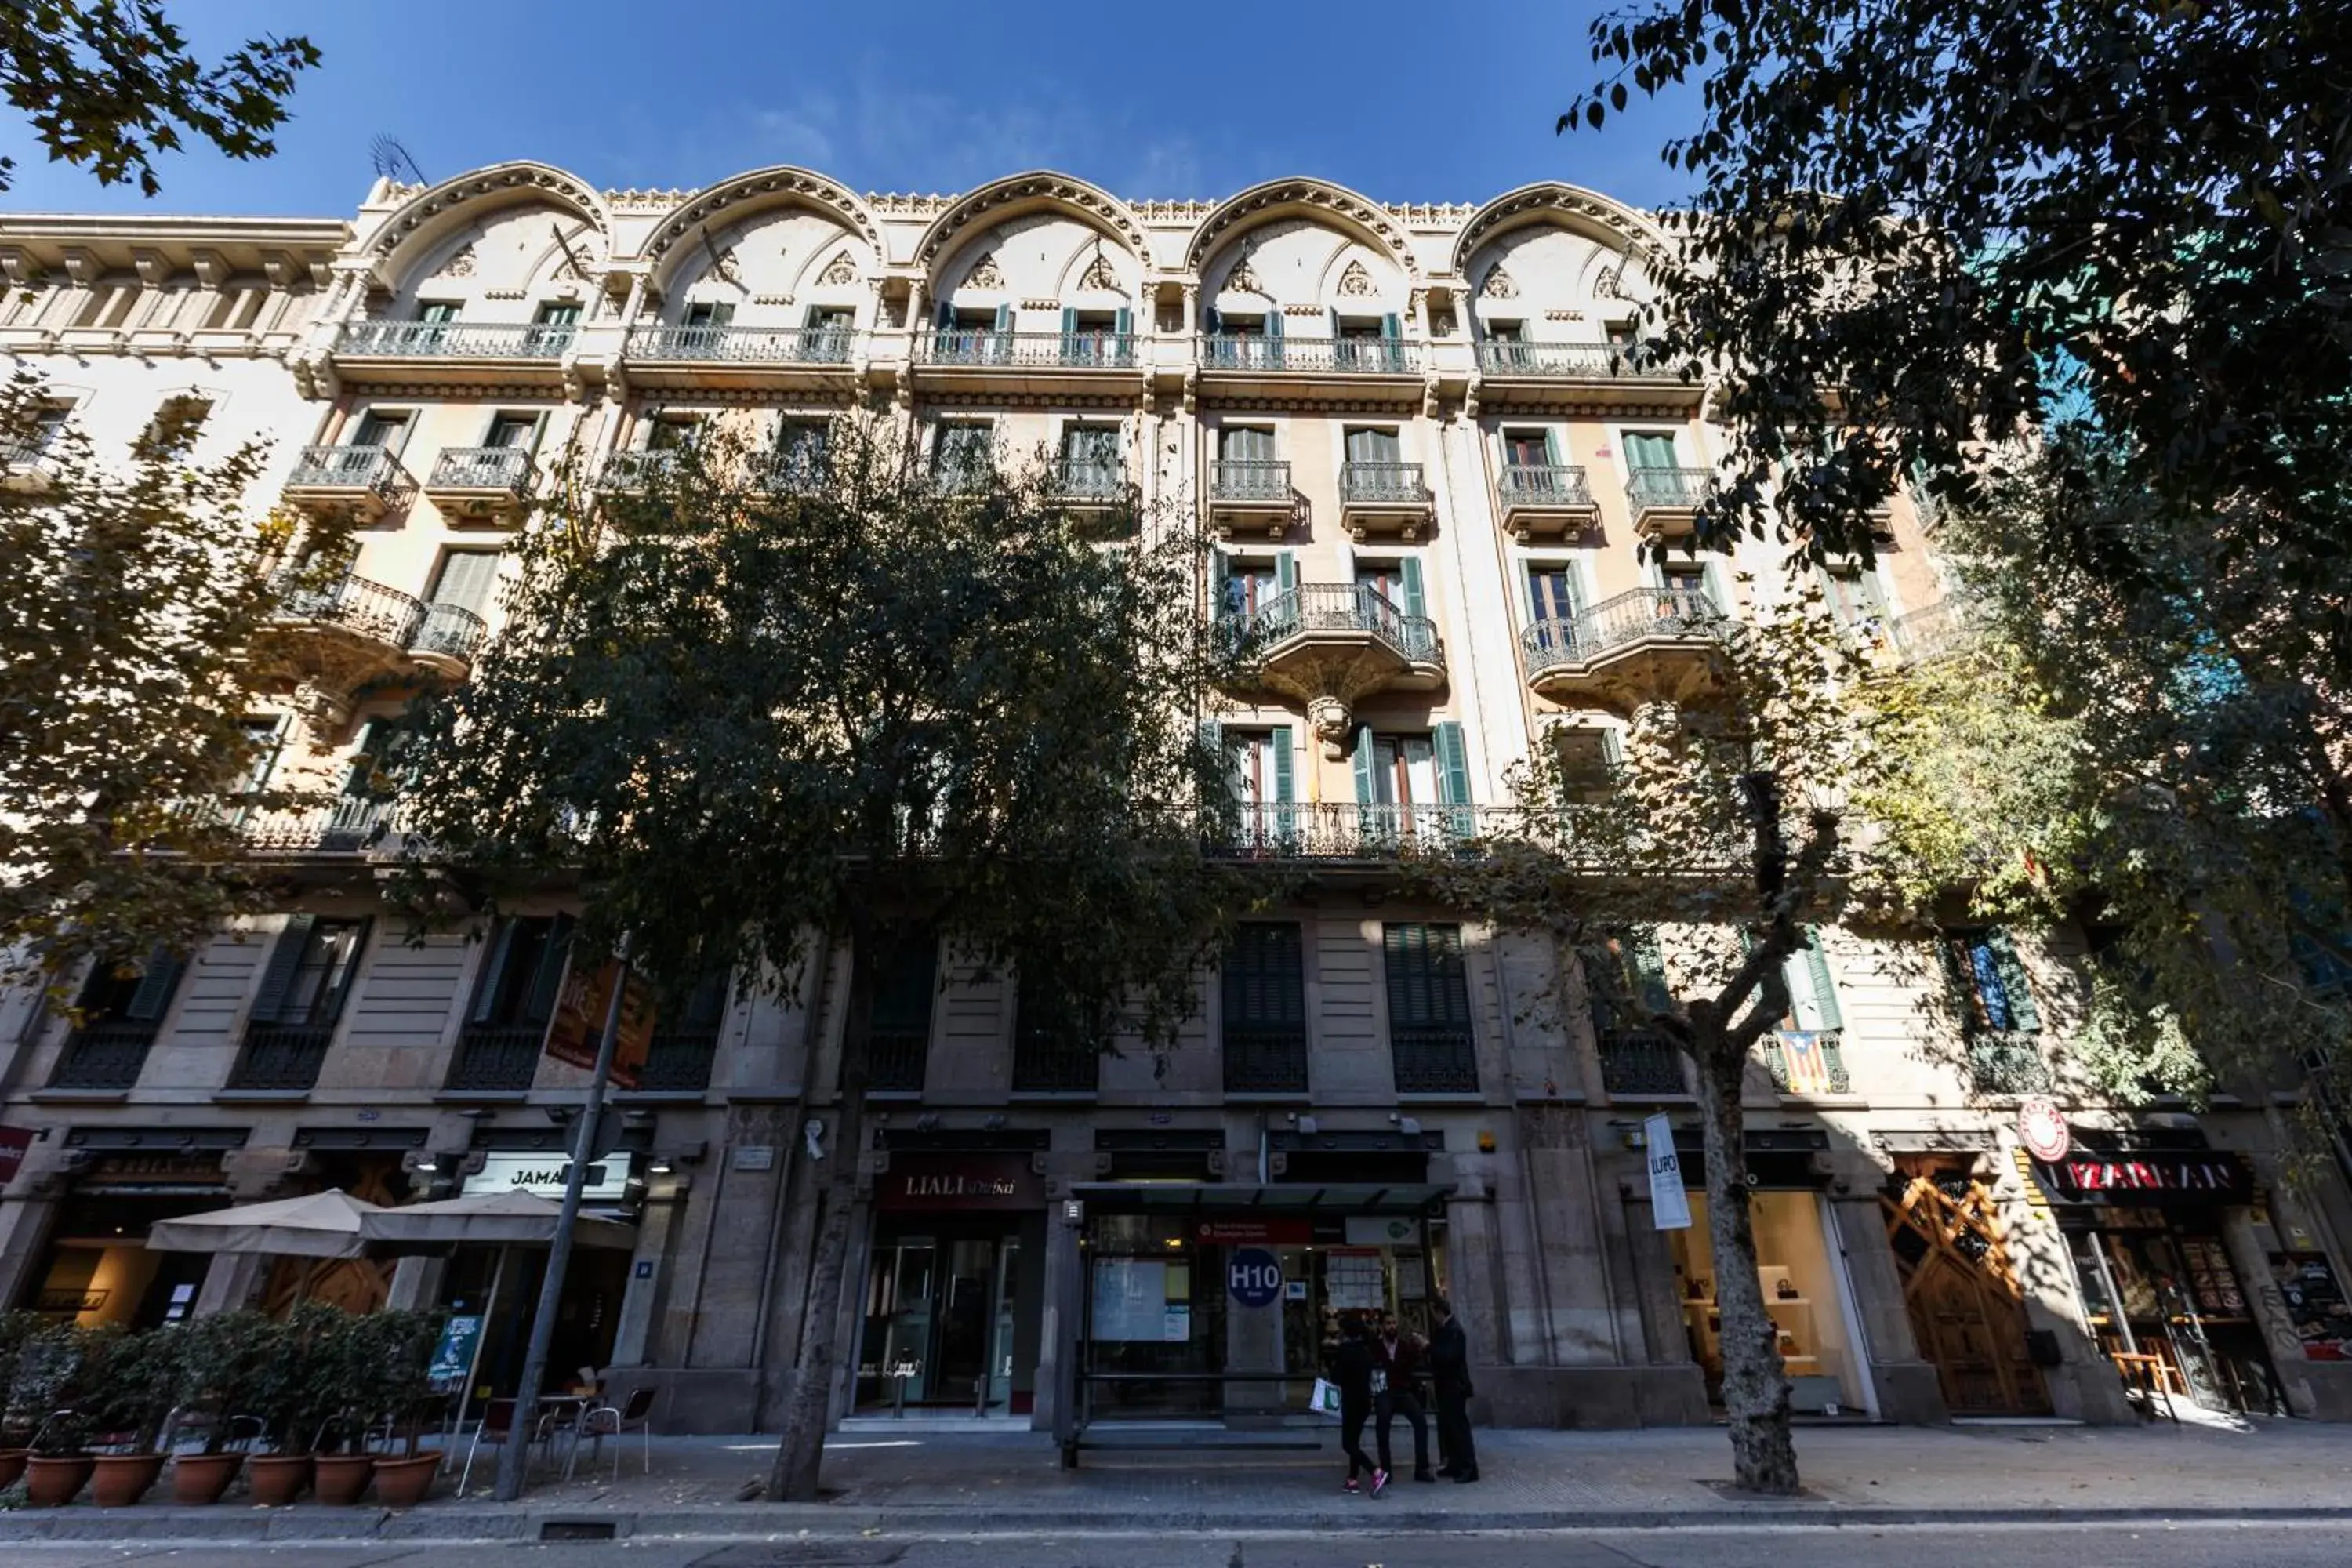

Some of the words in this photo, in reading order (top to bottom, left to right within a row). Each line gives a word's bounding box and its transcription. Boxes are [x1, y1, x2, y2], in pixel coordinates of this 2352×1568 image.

[1651, 1154, 1676, 1174] LUPO
[511, 1171, 564, 1185] JAMA
[905, 1175, 964, 1196] LIALI
[1230, 1264, 1280, 1289] H10
